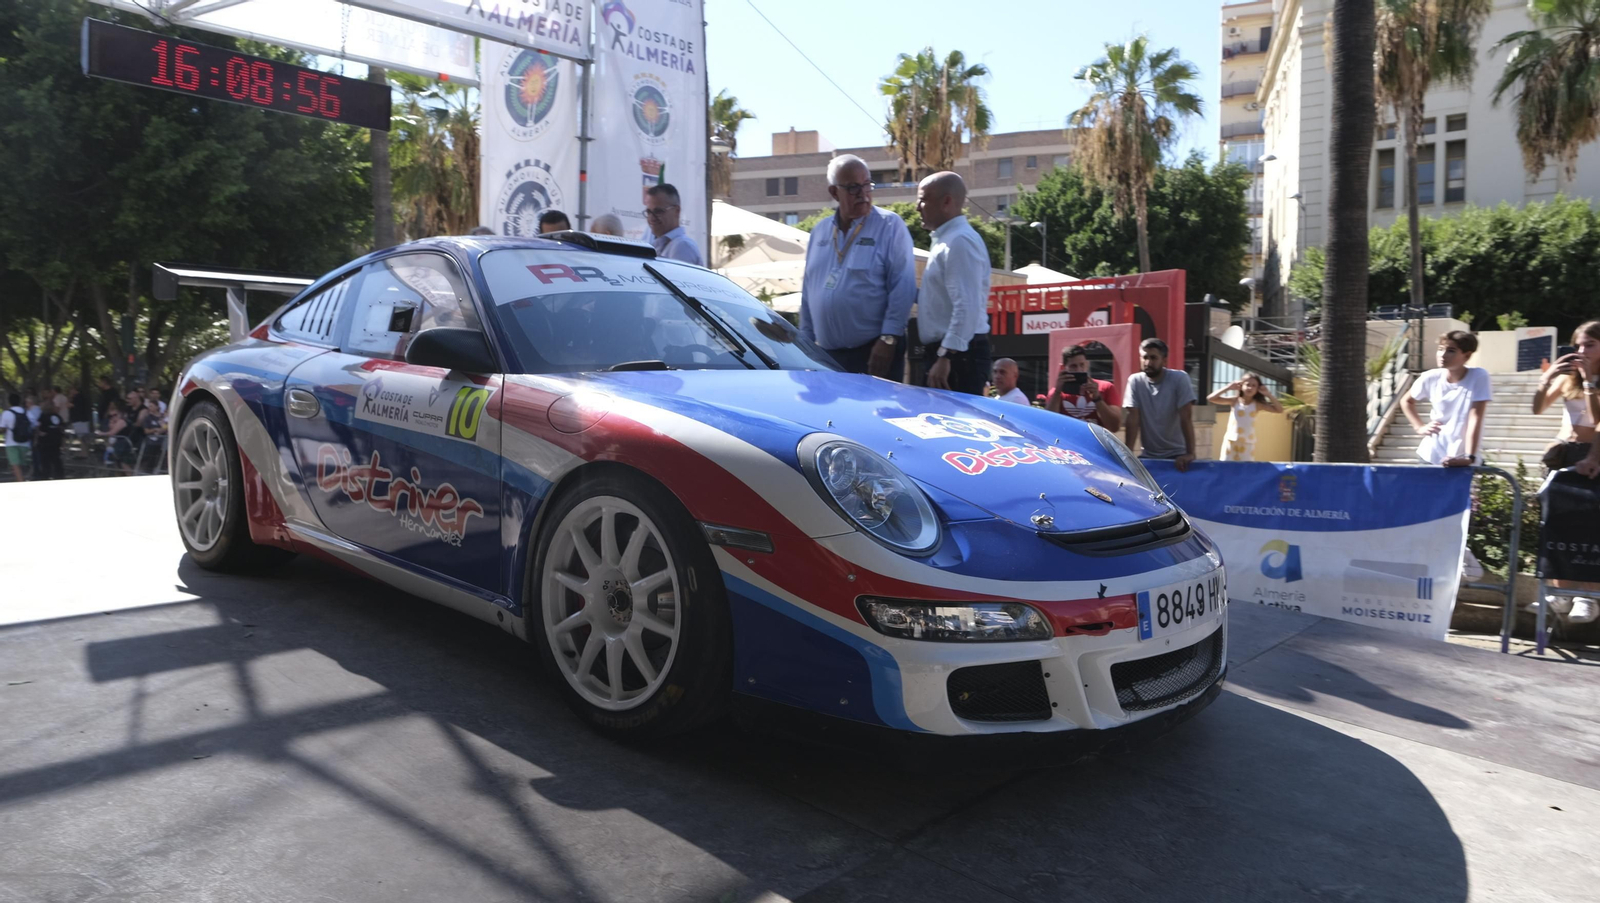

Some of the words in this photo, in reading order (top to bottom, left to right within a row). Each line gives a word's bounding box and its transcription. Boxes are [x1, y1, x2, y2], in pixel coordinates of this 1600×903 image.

[488, 3, 582, 47] ALMERÍA
[638, 25, 677, 49] COSTA
[679, 38, 694, 54] DE
[626, 40, 696, 75] ALMERÍA
[150, 40, 341, 118] 16:08:56
[370, 402, 409, 423] ALMERÍA
[380, 390, 402, 405] COSTA
[403, 395, 413, 406] DE
[448, 386, 489, 439] 10
[412, 410, 443, 423] CUPRA
[316, 444, 484, 540] Distriver
[1223, 504, 1286, 516] DIPUTACIÓN
[1287, 507, 1301, 518] DE
[1303, 509, 1351, 520] ALMERÍA
[1546, 541, 1600, 552] COSTA
[1157, 582, 1205, 629] 8849
[1142, 620, 1149, 632] E
